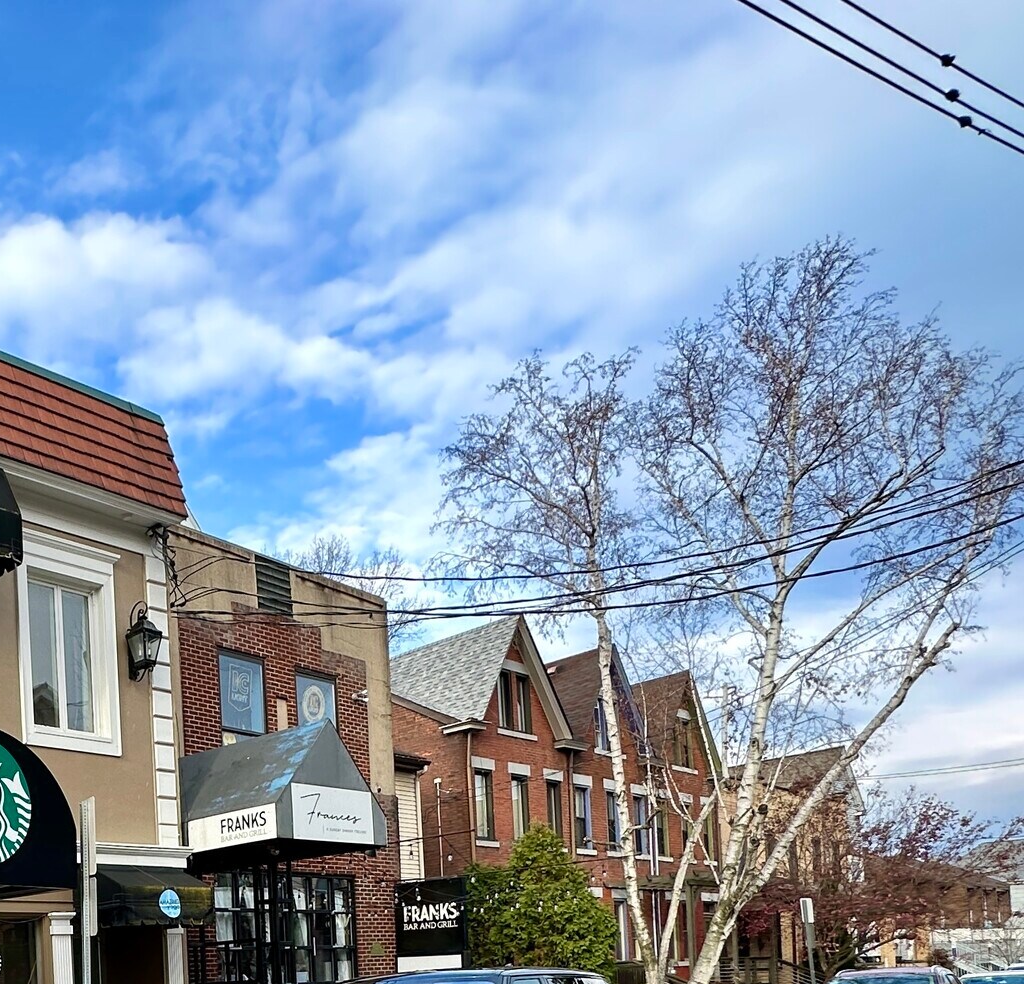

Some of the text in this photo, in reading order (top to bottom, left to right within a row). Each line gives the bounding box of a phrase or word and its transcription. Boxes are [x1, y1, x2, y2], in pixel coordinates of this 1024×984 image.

[300, 793, 362, 825] Frances
[220, 811, 267, 834] FRANKS
[221, 829, 268, 843] BAR AND GRILL
[403, 902, 458, 923] FRANKS
[403, 919, 458, 931] BAR AND GRILL
